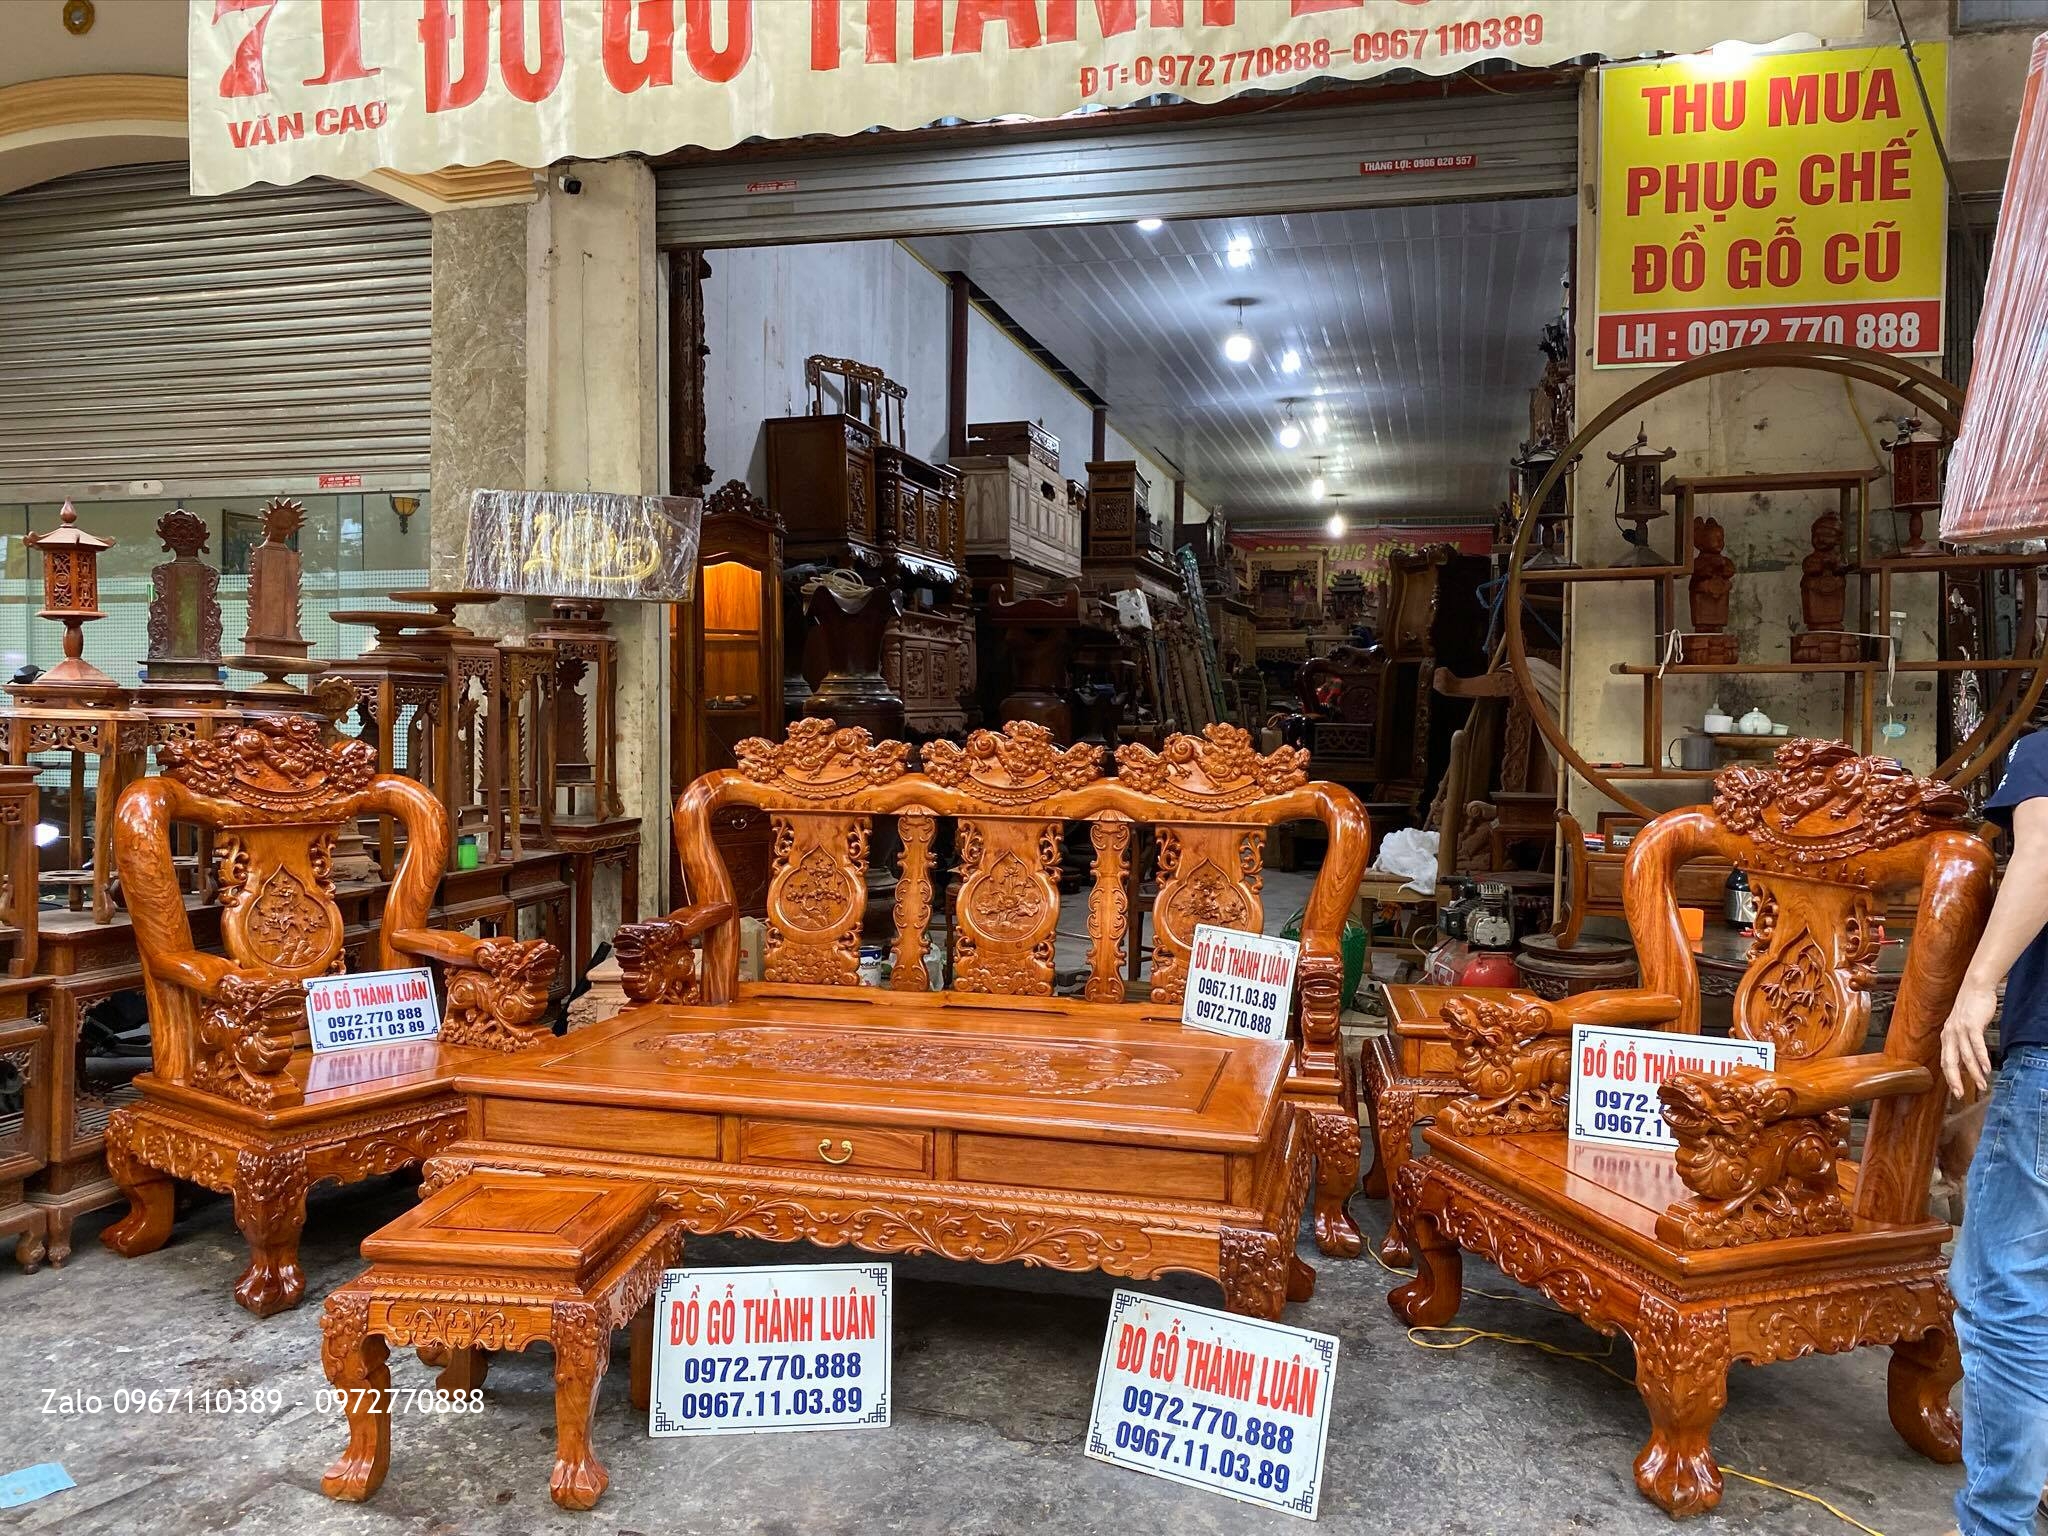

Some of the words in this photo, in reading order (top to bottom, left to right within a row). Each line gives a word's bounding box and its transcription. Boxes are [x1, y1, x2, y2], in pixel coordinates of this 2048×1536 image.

[227, 113, 304, 149] VĂN
[315, 101, 388, 136] CAO
[1641, 79, 1747, 136] THU
[1768, 68, 1901, 127] MUA
[1626, 157, 1777, 222] PHỤC
[1799, 129, 1919, 207] CHẾ
[1631, 223, 1706, 294] ĐỒ
[1727, 216, 1802, 289] GỖ
[1824, 220, 1900, 285] CŨ
[1687, 319, 1770, 357] 0972
[1781, 315, 1844, 344] 770
[1855, 311, 1920, 350] 888
[1227, 944, 1261, 981] THÀNH
[1261, 950, 1291, 987] LUÂN
[312, 985, 332, 1012] ĐỒ
[334, 982, 351, 1010] GỖ
[353, 983, 394, 1007] THÀNH
[396, 979, 428, 1003] LUÂN
[1196, 1000, 1272, 1035] 0972.770.888
[1198, 977, 1277, 1011] 0967.11.03.89
[1583, 1040, 1608, 1079] ĐỒ
[1613, 1041, 1637, 1082] GỖ
[670, 1285, 700, 1346] ĐỒ
[707, 1283, 736, 1346] GỖ
[743, 1289, 814, 1345] THÀNH
[820, 1286, 876, 1342] LUÂN
[683, 1352, 862, 1385] 0972.770.888
[1149, 1317, 1181, 1382] GỖ
[1183, 1336, 1256, 1402] THÀNH
[1256, 1353, 1320, 1418] LUÂN
[681, 1386, 863, 1420] 0967.11.03.89
[1122, 1385, 1294, 1454] 0972.770.888
[1115, 1420, 1290, 1493] 0967.11.03.89
